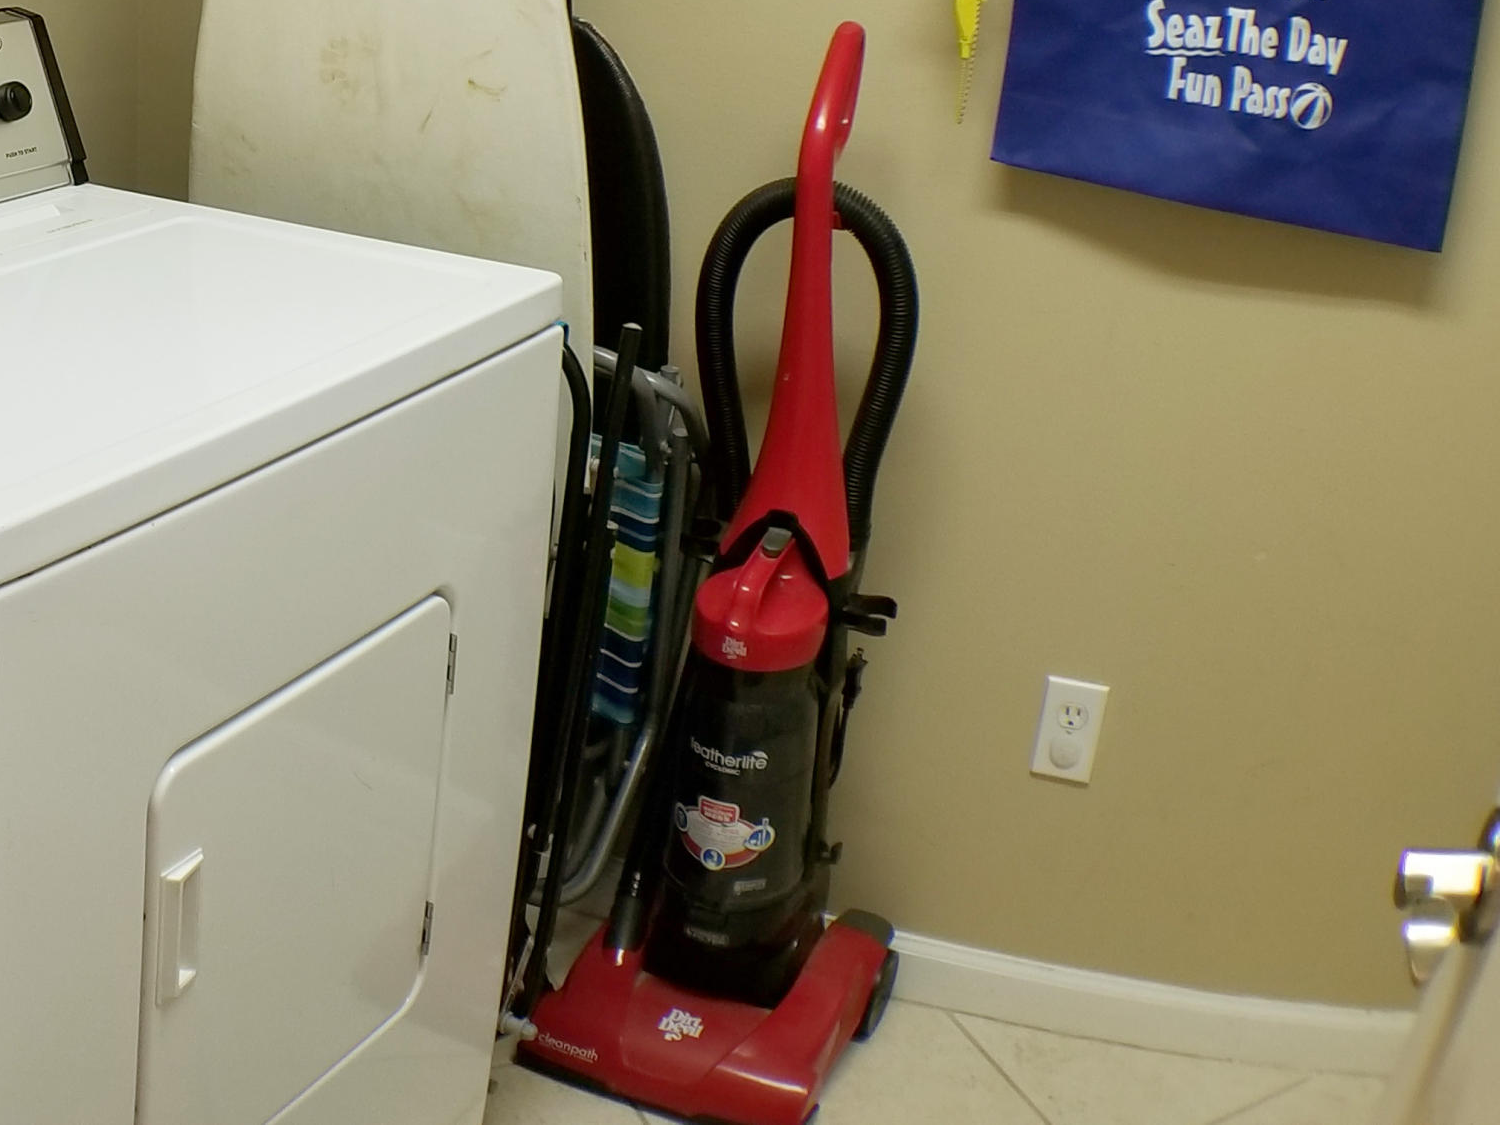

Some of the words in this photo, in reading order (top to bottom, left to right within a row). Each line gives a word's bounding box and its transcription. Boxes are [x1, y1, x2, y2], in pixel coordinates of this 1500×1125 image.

[1227, 6, 1279, 58] The
[1286, 15, 1348, 75] Day
[1167, 56, 1222, 107] Fun
[1229, 65, 1291, 119] Pass
[722, 642, 747, 657] Devil
[724, 635, 745, 648] Dirt
[657, 1015, 705, 1039] Devil
[669, 1007, 703, 1028] Dirt
[538, 1032, 599, 1062] cleanpath
